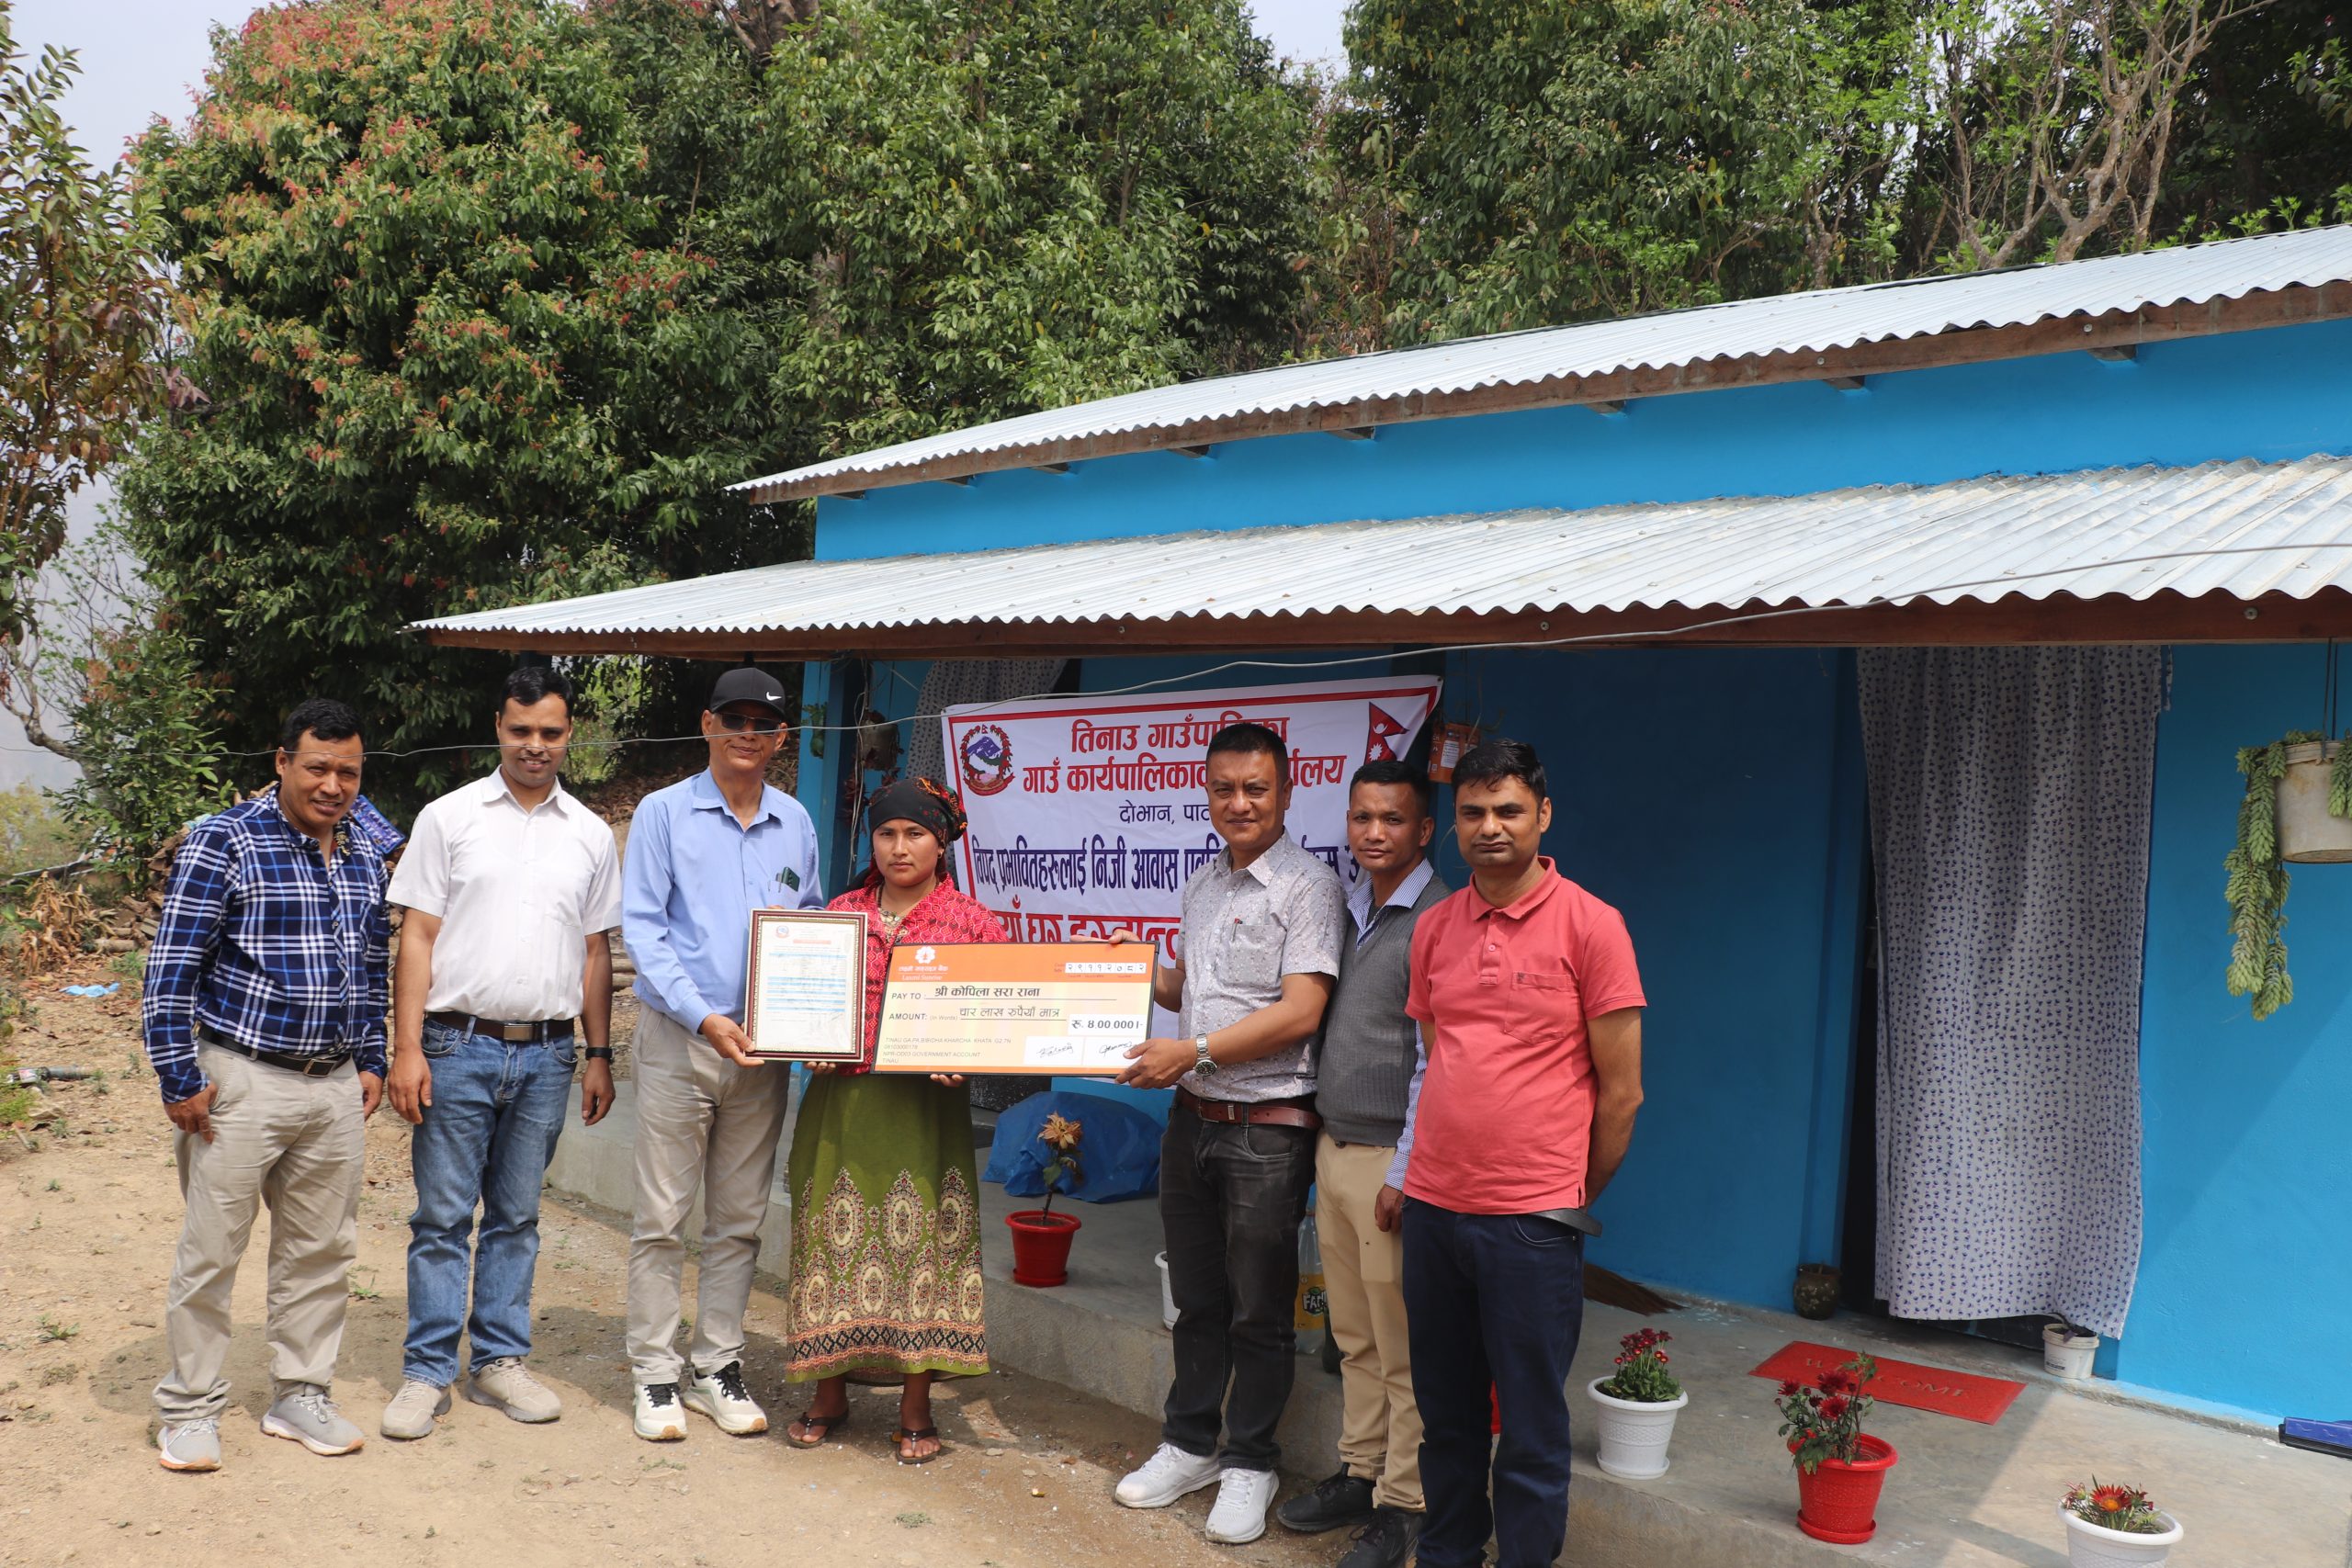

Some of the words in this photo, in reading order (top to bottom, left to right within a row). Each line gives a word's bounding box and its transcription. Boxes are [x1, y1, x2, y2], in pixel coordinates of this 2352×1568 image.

[1071, 718, 1140, 753] तिनाउ
[1023, 756, 1061, 794] गाउँ
[1119, 799, 1175, 825] दोभान,
[1091, 834, 1127, 889] निजी
[1131, 849, 1179, 893] आवास
[934, 986, 947, 997] श्री
[951, 985, 989, 997] कोपिला
[1017, 987, 1041, 998] राना
[959, 1008, 978, 1017] चार
[980, 1008, 1003, 1018] लाख
[1039, 1008, 1060, 1018] मात्र
